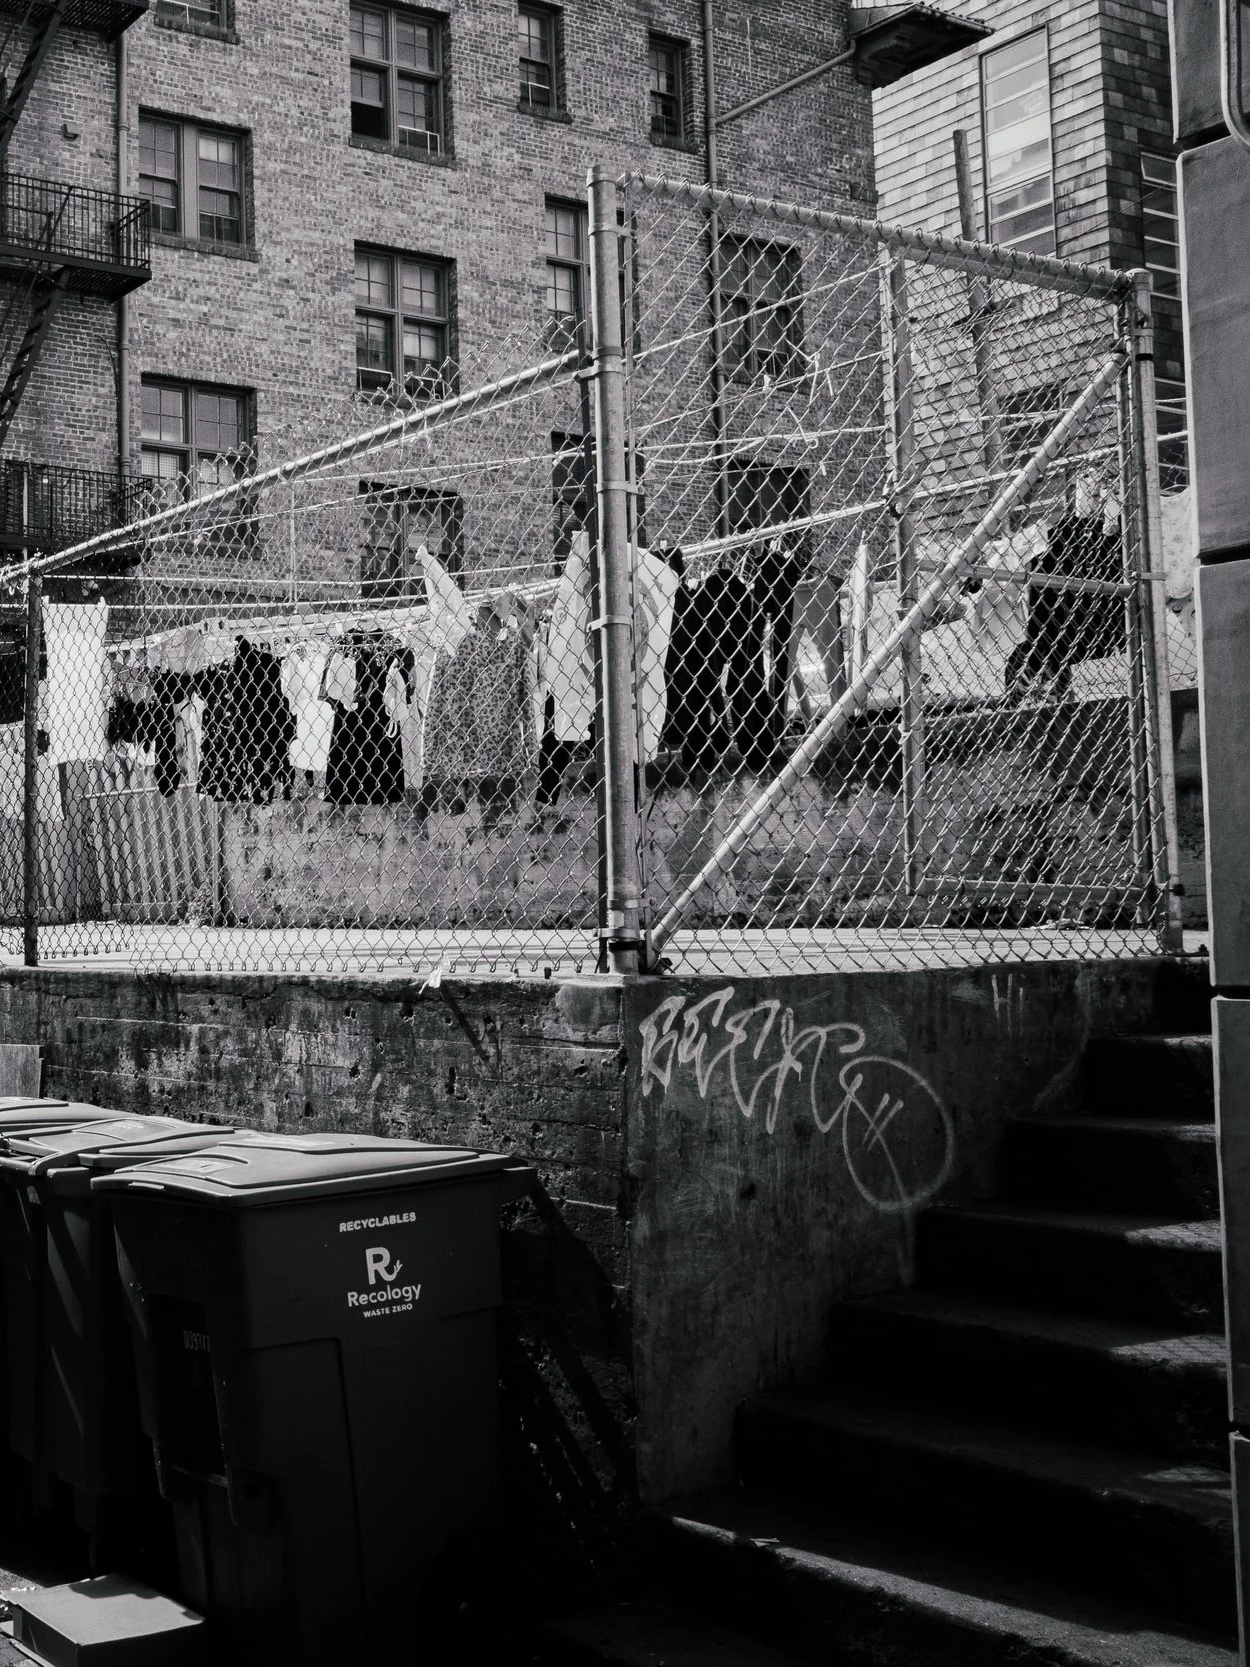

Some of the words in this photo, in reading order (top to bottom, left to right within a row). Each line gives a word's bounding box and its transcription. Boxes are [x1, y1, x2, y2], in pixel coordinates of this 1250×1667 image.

[339, 1212, 417, 1232] RECYCLABLES
[365, 1247, 403, 1285] R
[347, 1284, 421, 1307] Recology
[363, 1307, 390, 1318] WASTE
[392, 1303, 413, 1313] ZERO
